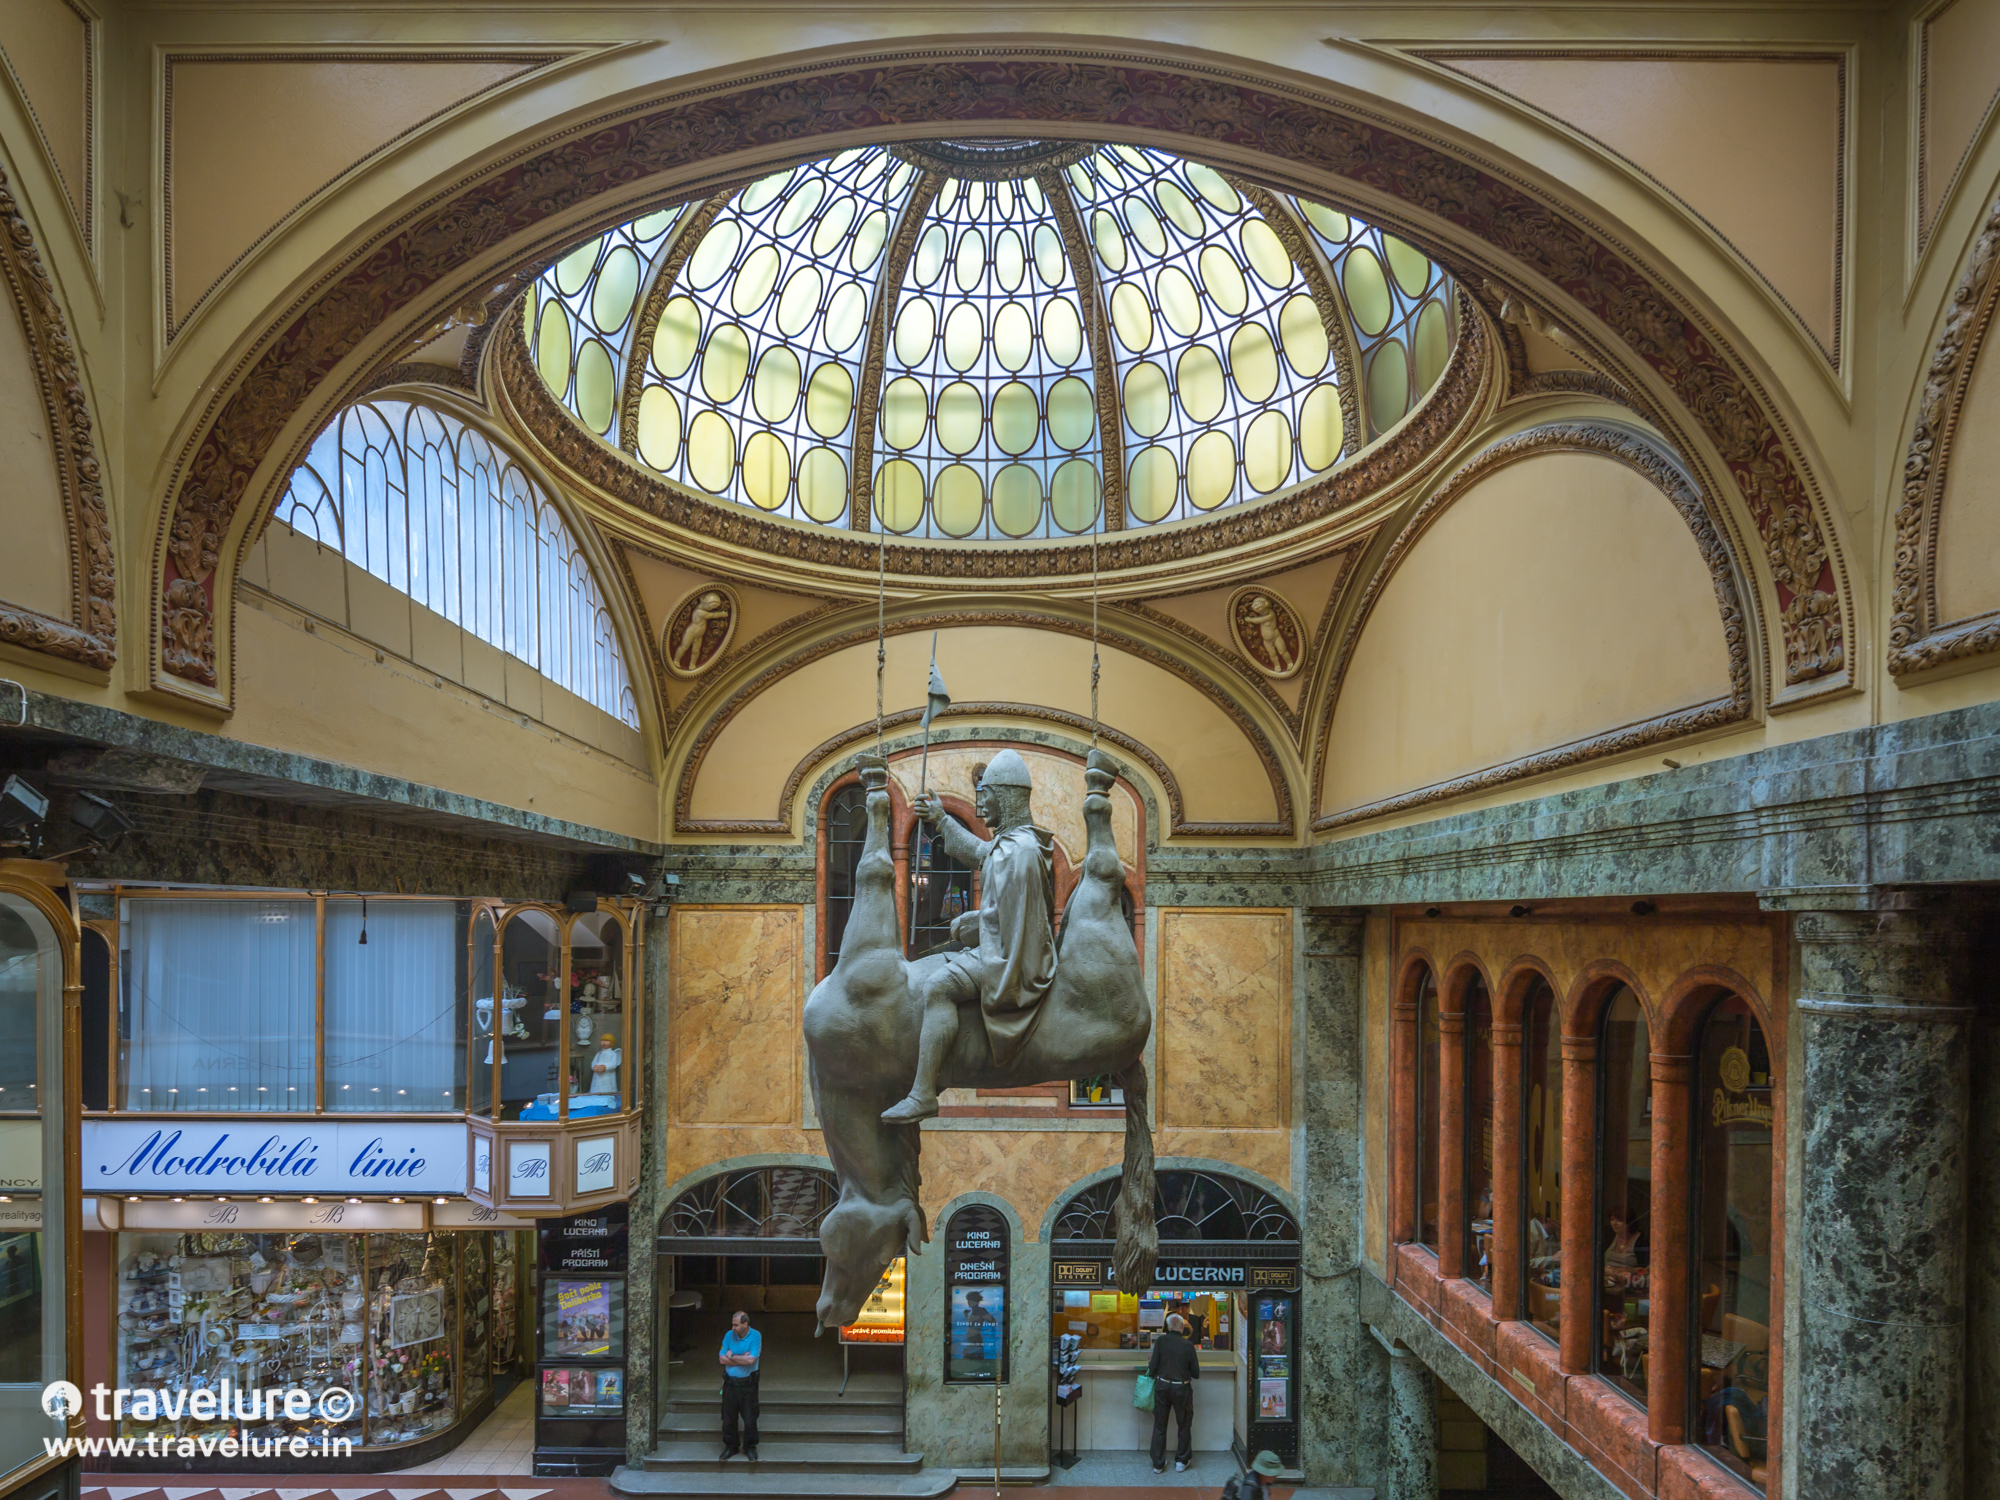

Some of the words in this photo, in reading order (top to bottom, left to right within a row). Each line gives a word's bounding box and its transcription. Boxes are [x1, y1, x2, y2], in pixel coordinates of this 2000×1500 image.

[1712, 1088, 1748, 1127] Pilsner
[100, 1129, 319, 1176] Modrobílá
[349, 1137, 427, 1177] linie
[0, 1210, 43, 1222] realityag
[574, 1219, 597, 1227] KINO
[563, 1228, 608, 1236] LUCERNA
[966, 1231, 990, 1240] KINO
[956, 1240, 1001, 1249] LUCERNA
[570, 1248, 600, 1258] PŘÍŠTÍ
[562, 1259, 609, 1267] PROGRAM
[960, 1261, 995, 1271] DNEŠNÍ
[954, 1271, 1001, 1280] PROGRAM
[1154, 1267, 1244, 1281] LUCERNA
